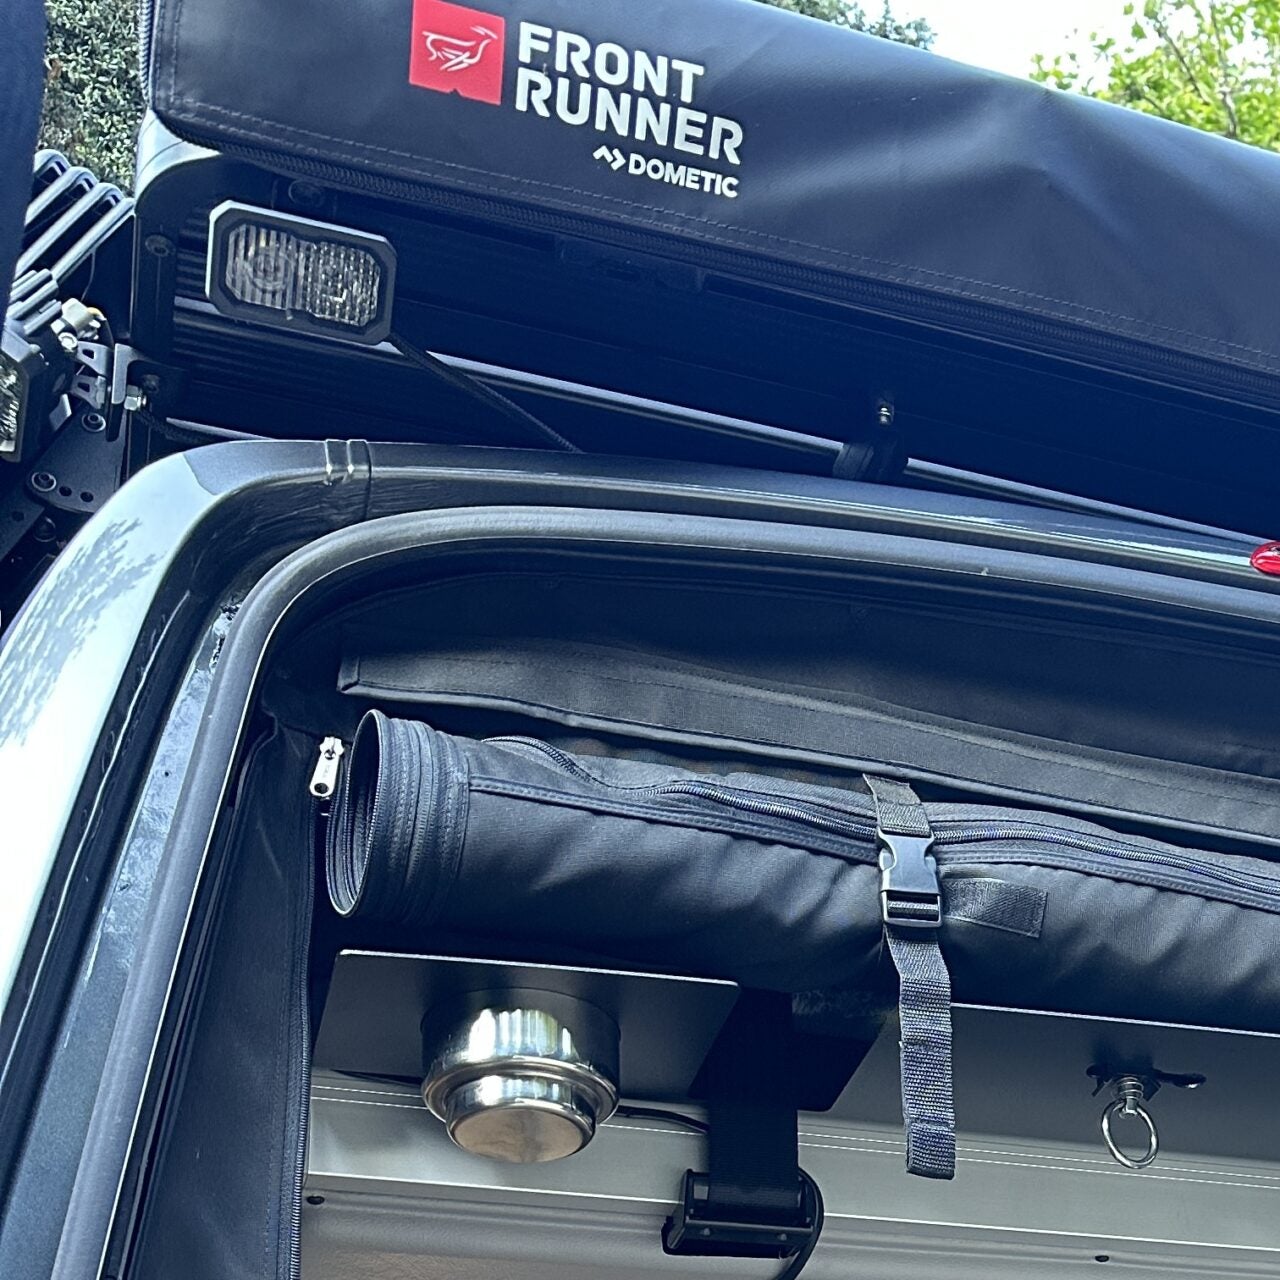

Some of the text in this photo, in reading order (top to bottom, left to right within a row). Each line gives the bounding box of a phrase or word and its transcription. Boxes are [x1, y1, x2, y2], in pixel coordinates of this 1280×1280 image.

[518, 21, 705, 104] FRONT
[514, 67, 744, 166] RUNNER
[627, 152, 740, 198] DOMETIC
